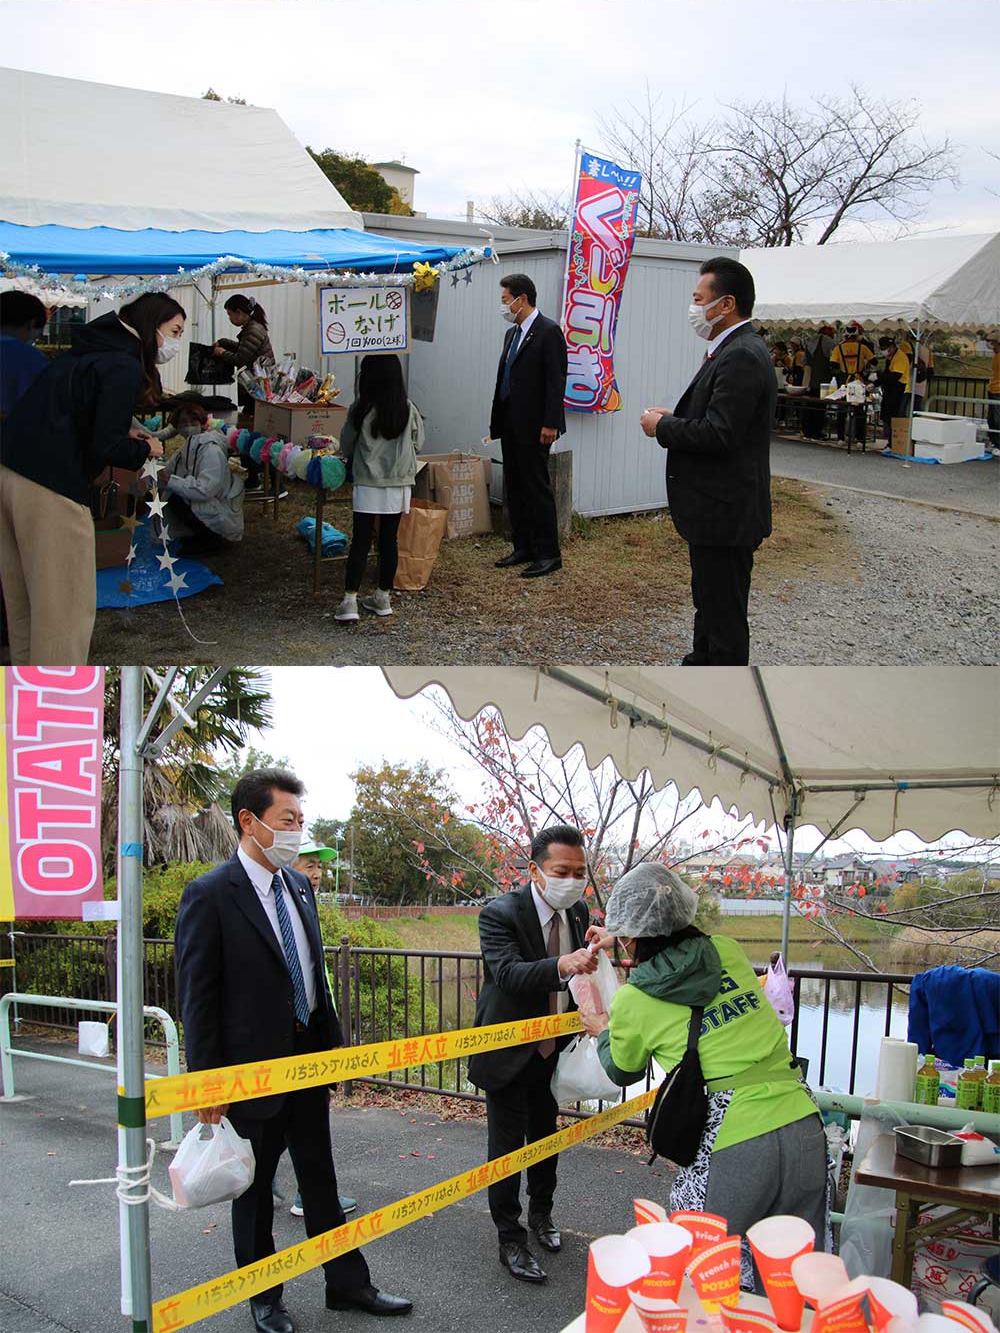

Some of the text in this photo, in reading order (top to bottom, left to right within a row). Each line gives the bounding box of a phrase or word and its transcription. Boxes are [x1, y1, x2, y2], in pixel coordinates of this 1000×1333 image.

[328, 293, 386, 314] ボール
[355, 314, 400, 334] なげ
[698, 1260, 730, 1281] French
